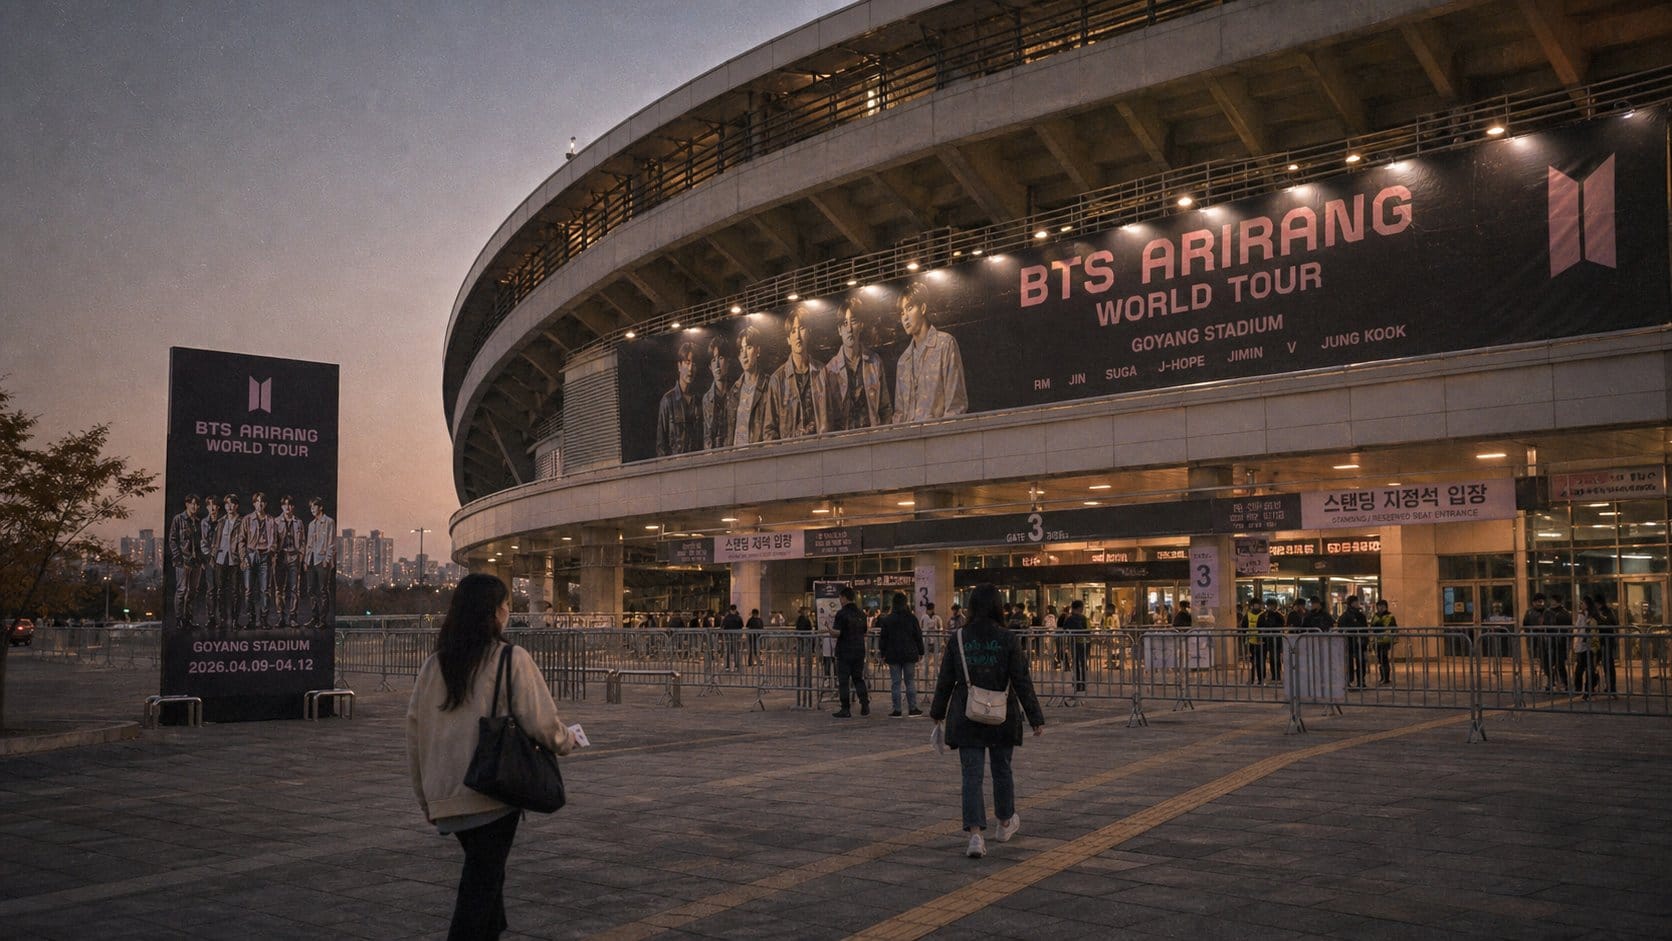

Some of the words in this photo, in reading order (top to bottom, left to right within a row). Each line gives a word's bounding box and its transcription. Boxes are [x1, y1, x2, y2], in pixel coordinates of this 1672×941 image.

[1020, 250, 1115, 307] BTS
[1141, 184, 1413, 285] ARIRANG
[1096, 282, 1212, 327] WORLD
[1227, 261, 1322, 303] TOUR
[1131, 326, 1199, 353] GOYANG
[1204, 314, 1284, 342] STADIUM
[1034, 378, 1051, 391] RM
[1068, 373, 1086, 386] JIN
[1105, 365, 1137, 380] SUGA
[1158, 355, 1205, 373] J-HOPE
[1227, 346, 1263, 363] JIMIN
[1287, 341, 1297, 354] V
[1321, 331, 1360, 350] JUNG
[1364, 324, 1407, 343] KOOK
[195, 420, 232, 437] BTS
[240, 424, 319, 443] ARIRANG
[206, 439, 263, 454] WORLD
[268, 443, 309, 457] TOUR
[1324, 491, 1376, 512] 스탠딩
[1383, 487, 1439, 509] 지정석
[1448, 483, 1488, 505] 입장
[1006, 532, 1025, 543] GATE
[1027, 513, 1044, 542] 3
[1196, 564, 1212, 588] 3
[919, 586, 929, 607] 3
[193, 640, 249, 652] GOYANG
[252, 639, 310, 652] STADIUM
[188, 658, 314, 673] 2026.04.09-04.12
